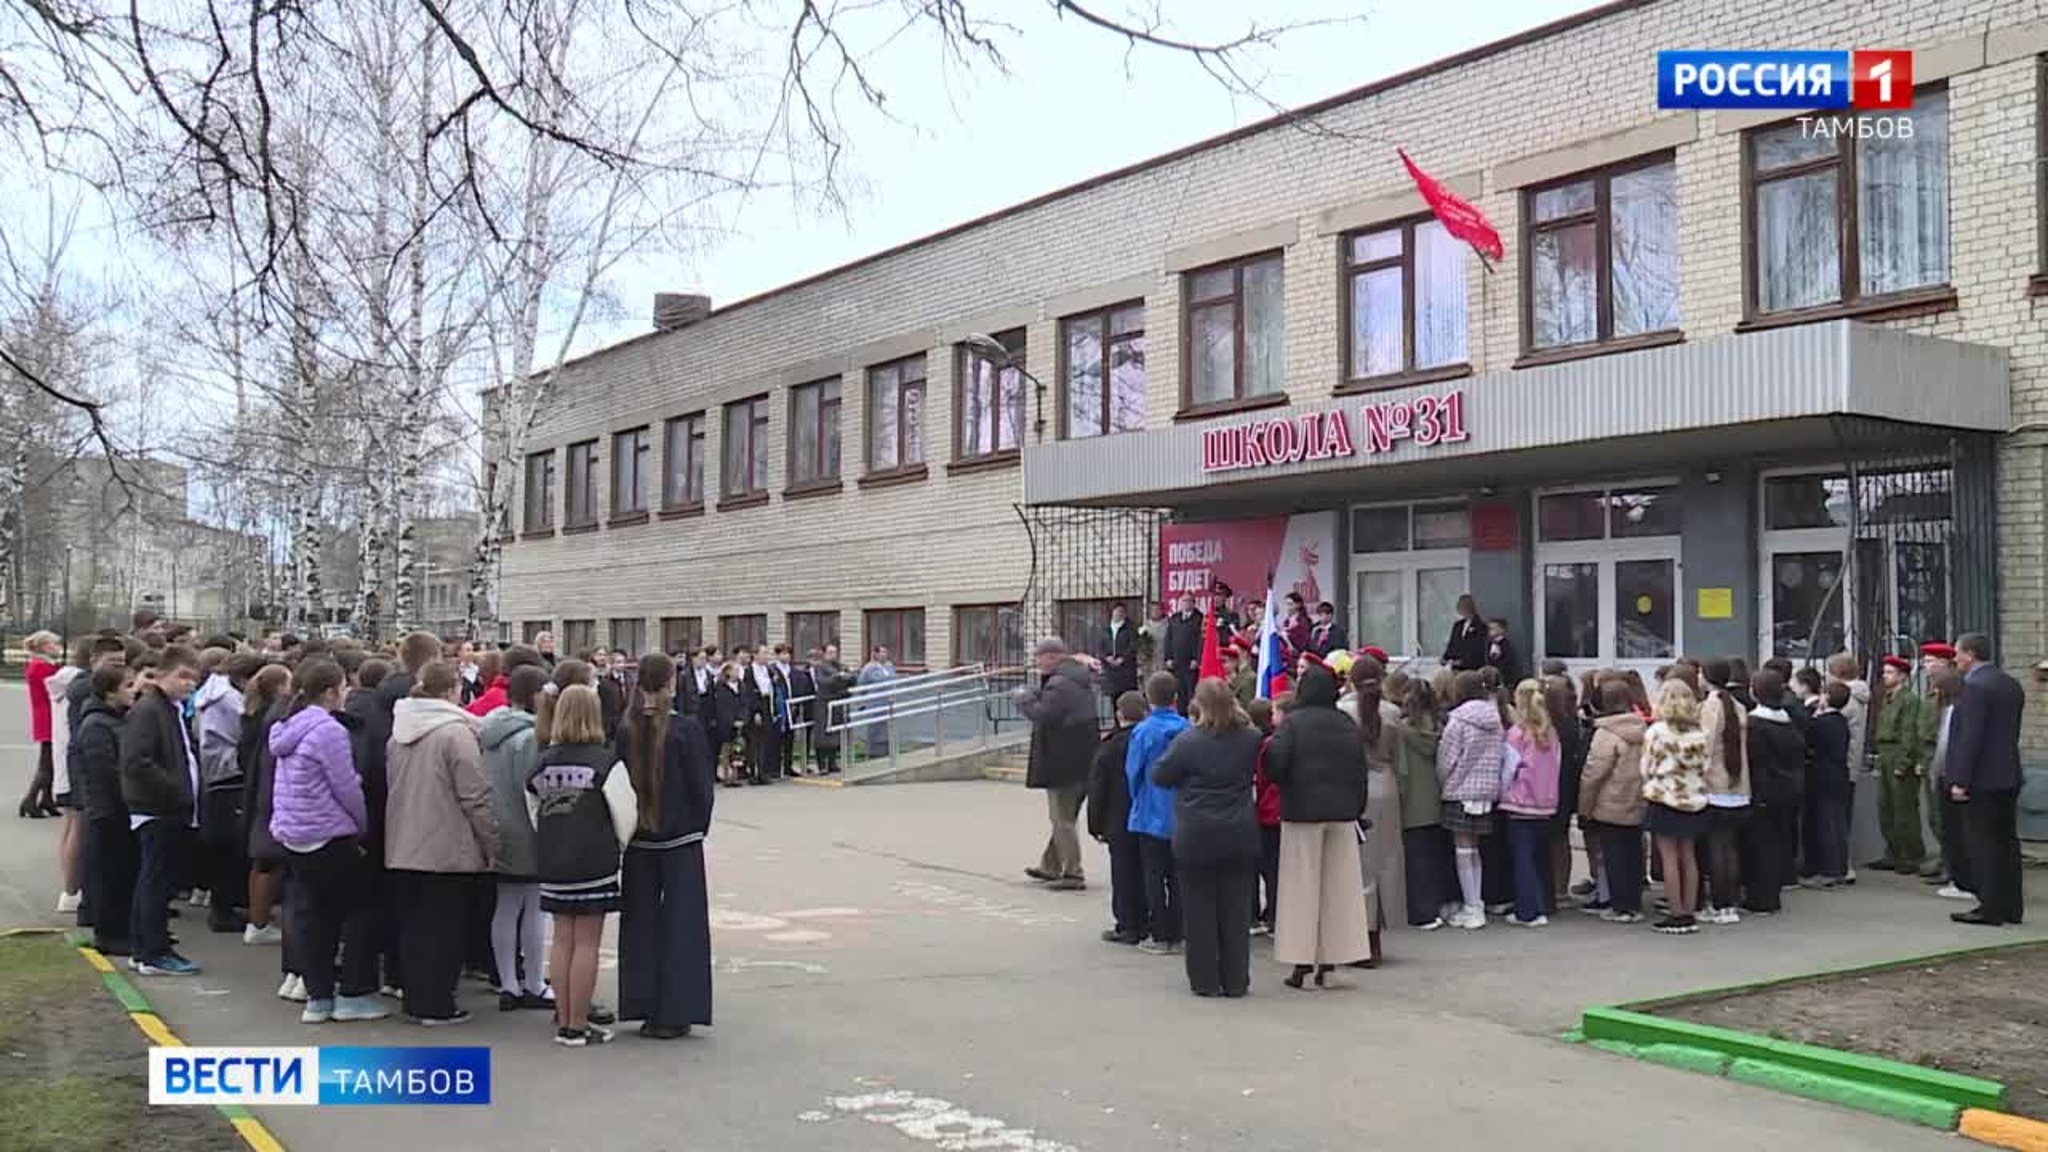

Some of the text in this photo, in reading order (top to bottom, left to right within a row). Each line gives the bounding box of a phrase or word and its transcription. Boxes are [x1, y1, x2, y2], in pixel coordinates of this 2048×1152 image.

[1202, 409, 1353, 472] ШКОЛА
[1168, 540, 1222, 565] ПОБЕДА
[1168, 568, 1210, 592] БУДЕТ
